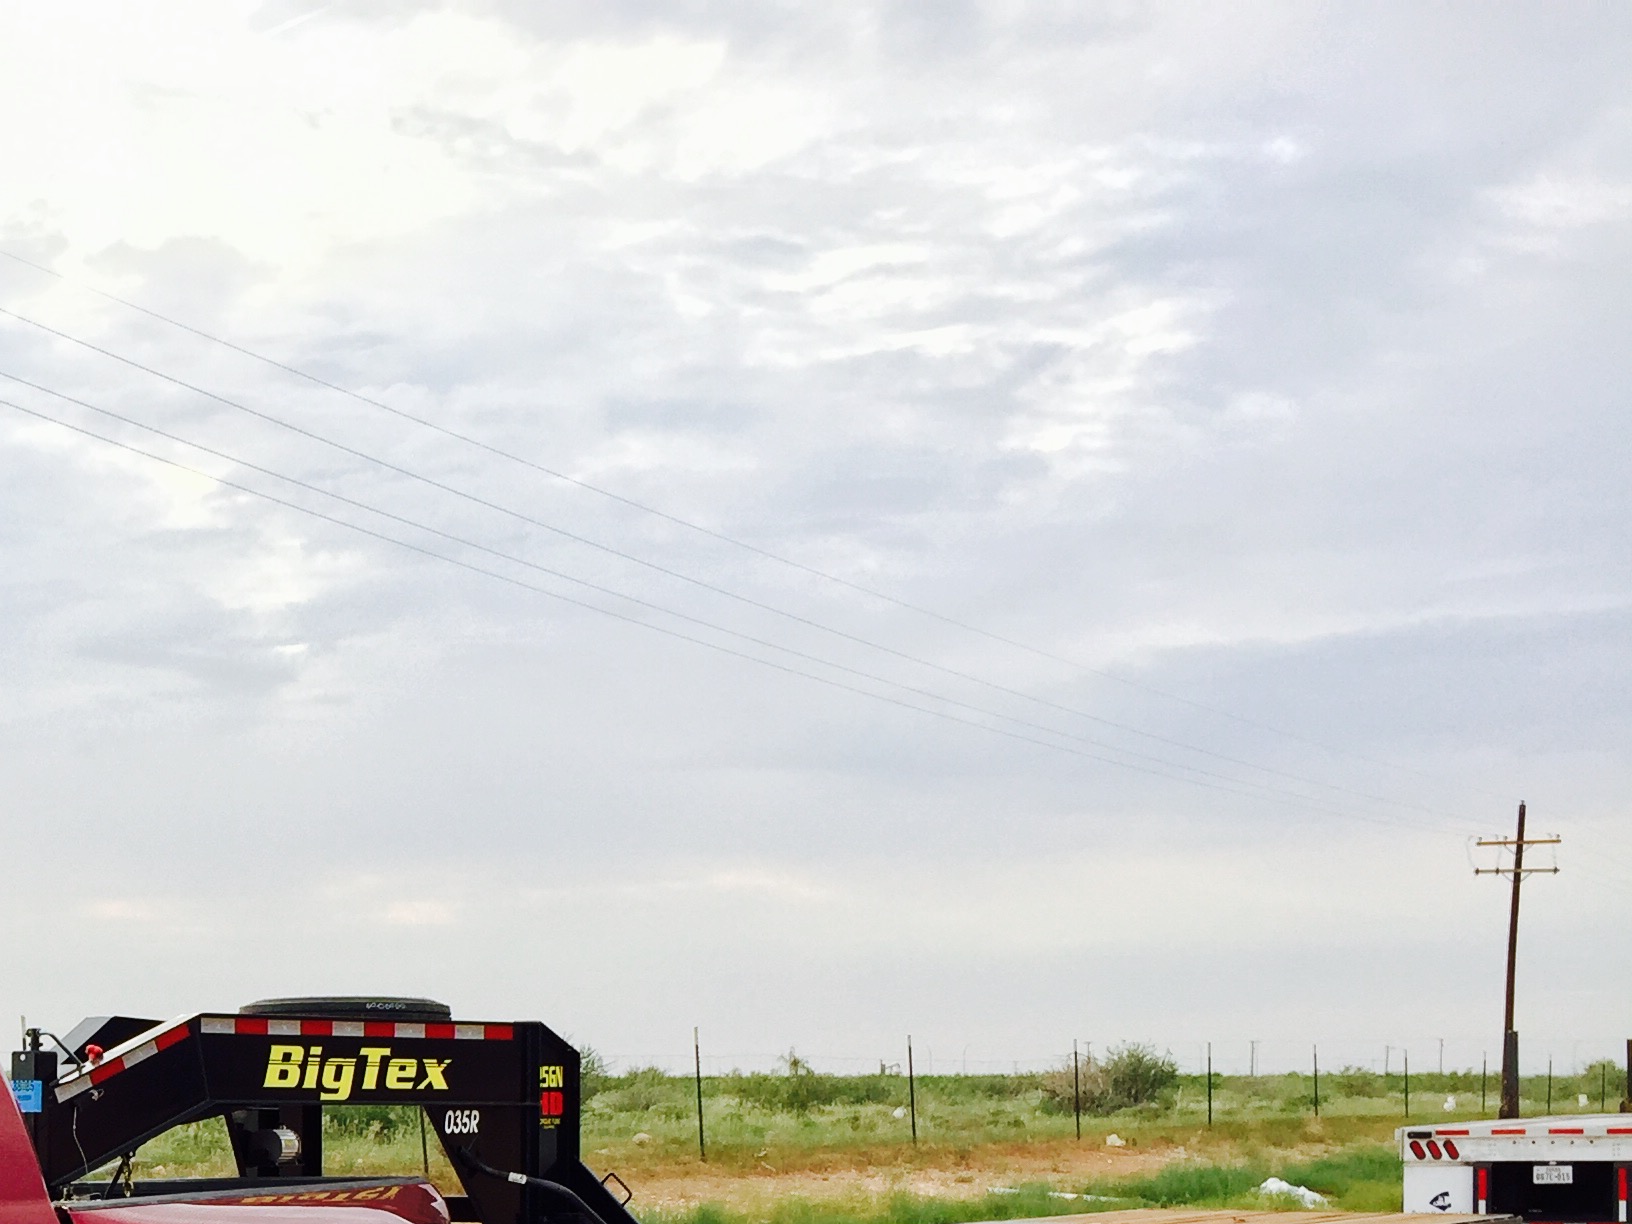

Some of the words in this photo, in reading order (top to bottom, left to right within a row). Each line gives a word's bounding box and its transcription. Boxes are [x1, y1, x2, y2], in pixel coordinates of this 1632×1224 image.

[263, 1045, 452, 1101] BigTex
[539, 1065, 564, 1088] 5GN
[444, 1110, 480, 1134] 035R
